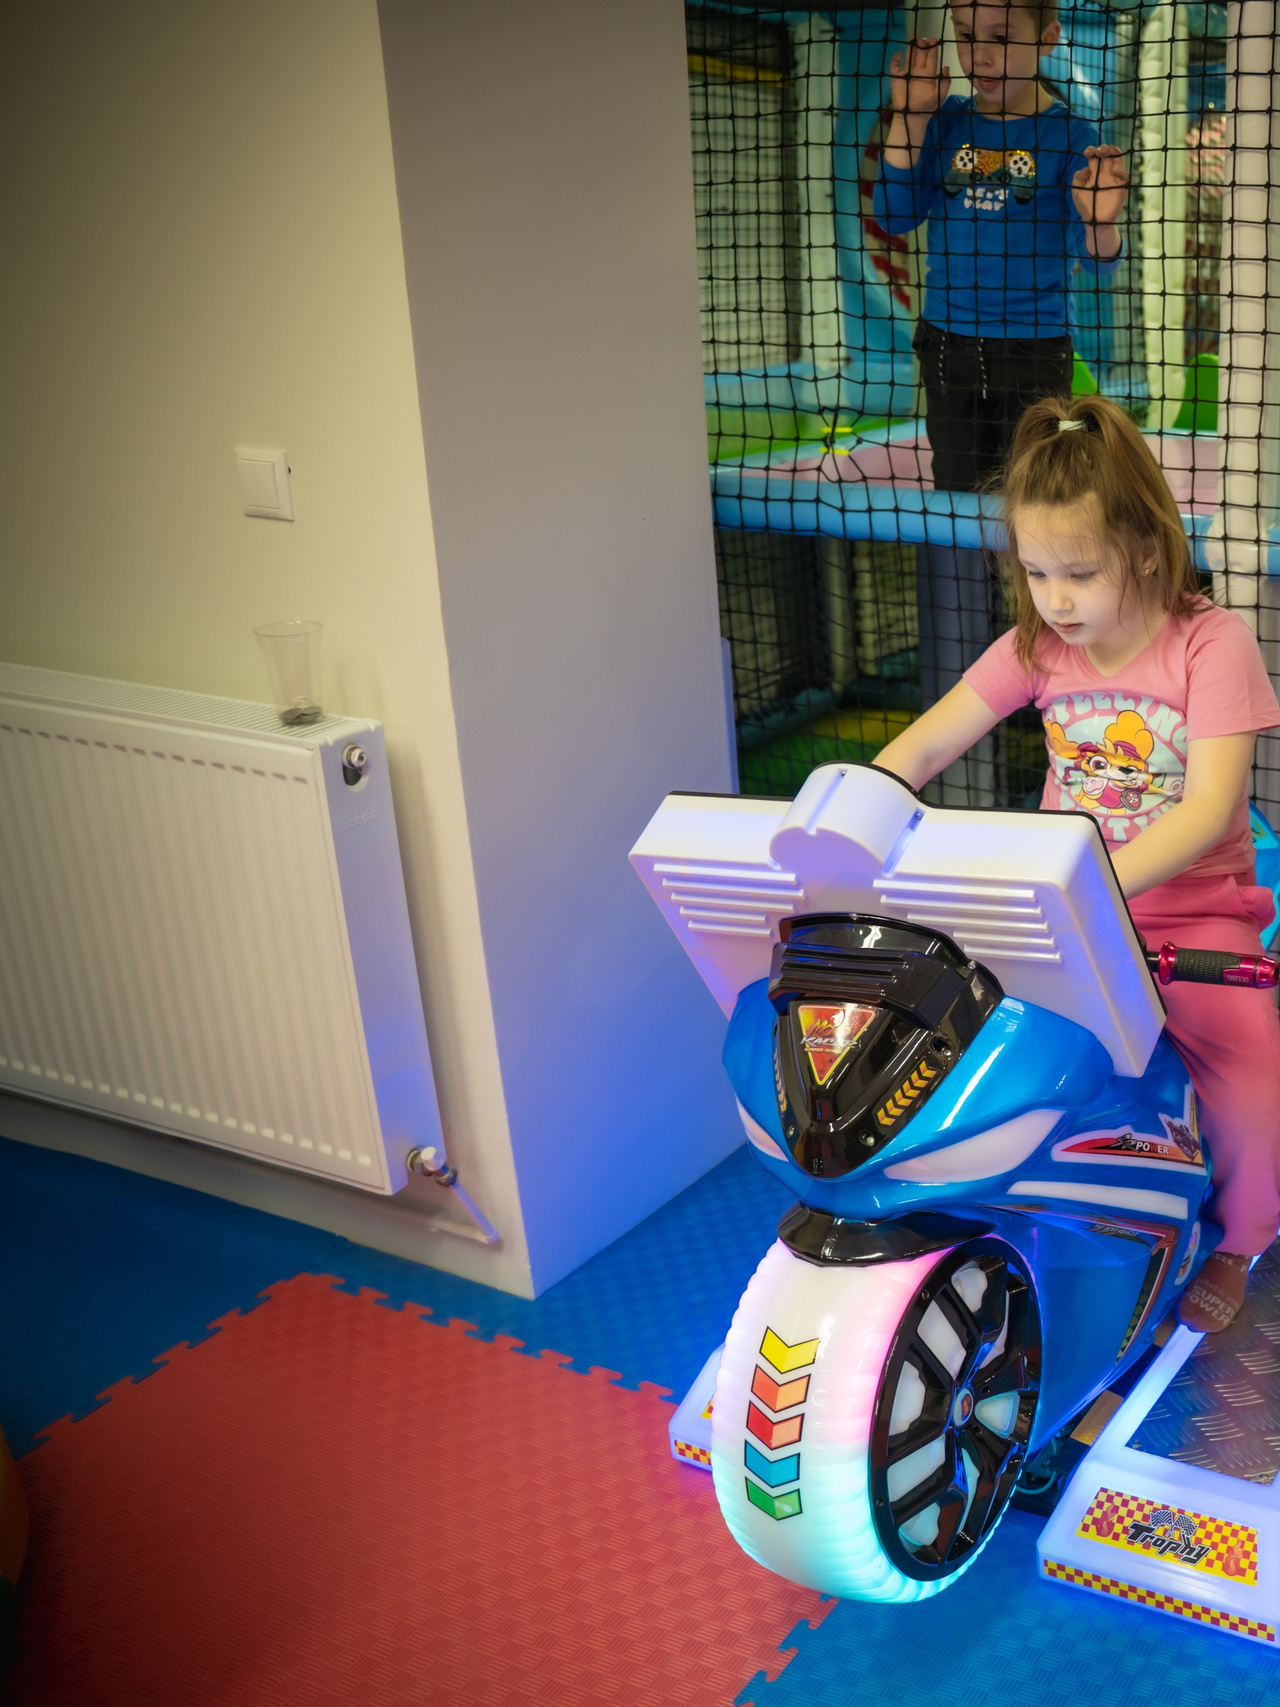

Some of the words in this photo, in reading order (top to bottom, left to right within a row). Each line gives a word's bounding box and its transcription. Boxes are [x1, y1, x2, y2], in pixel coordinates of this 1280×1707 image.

[1136, 1141, 1169, 1155] POWER
[1187, 1292, 1230, 1326] OWER
[1192, 1285, 1235, 1318] SUPER
[1125, 1522, 1212, 1566] Trophy
